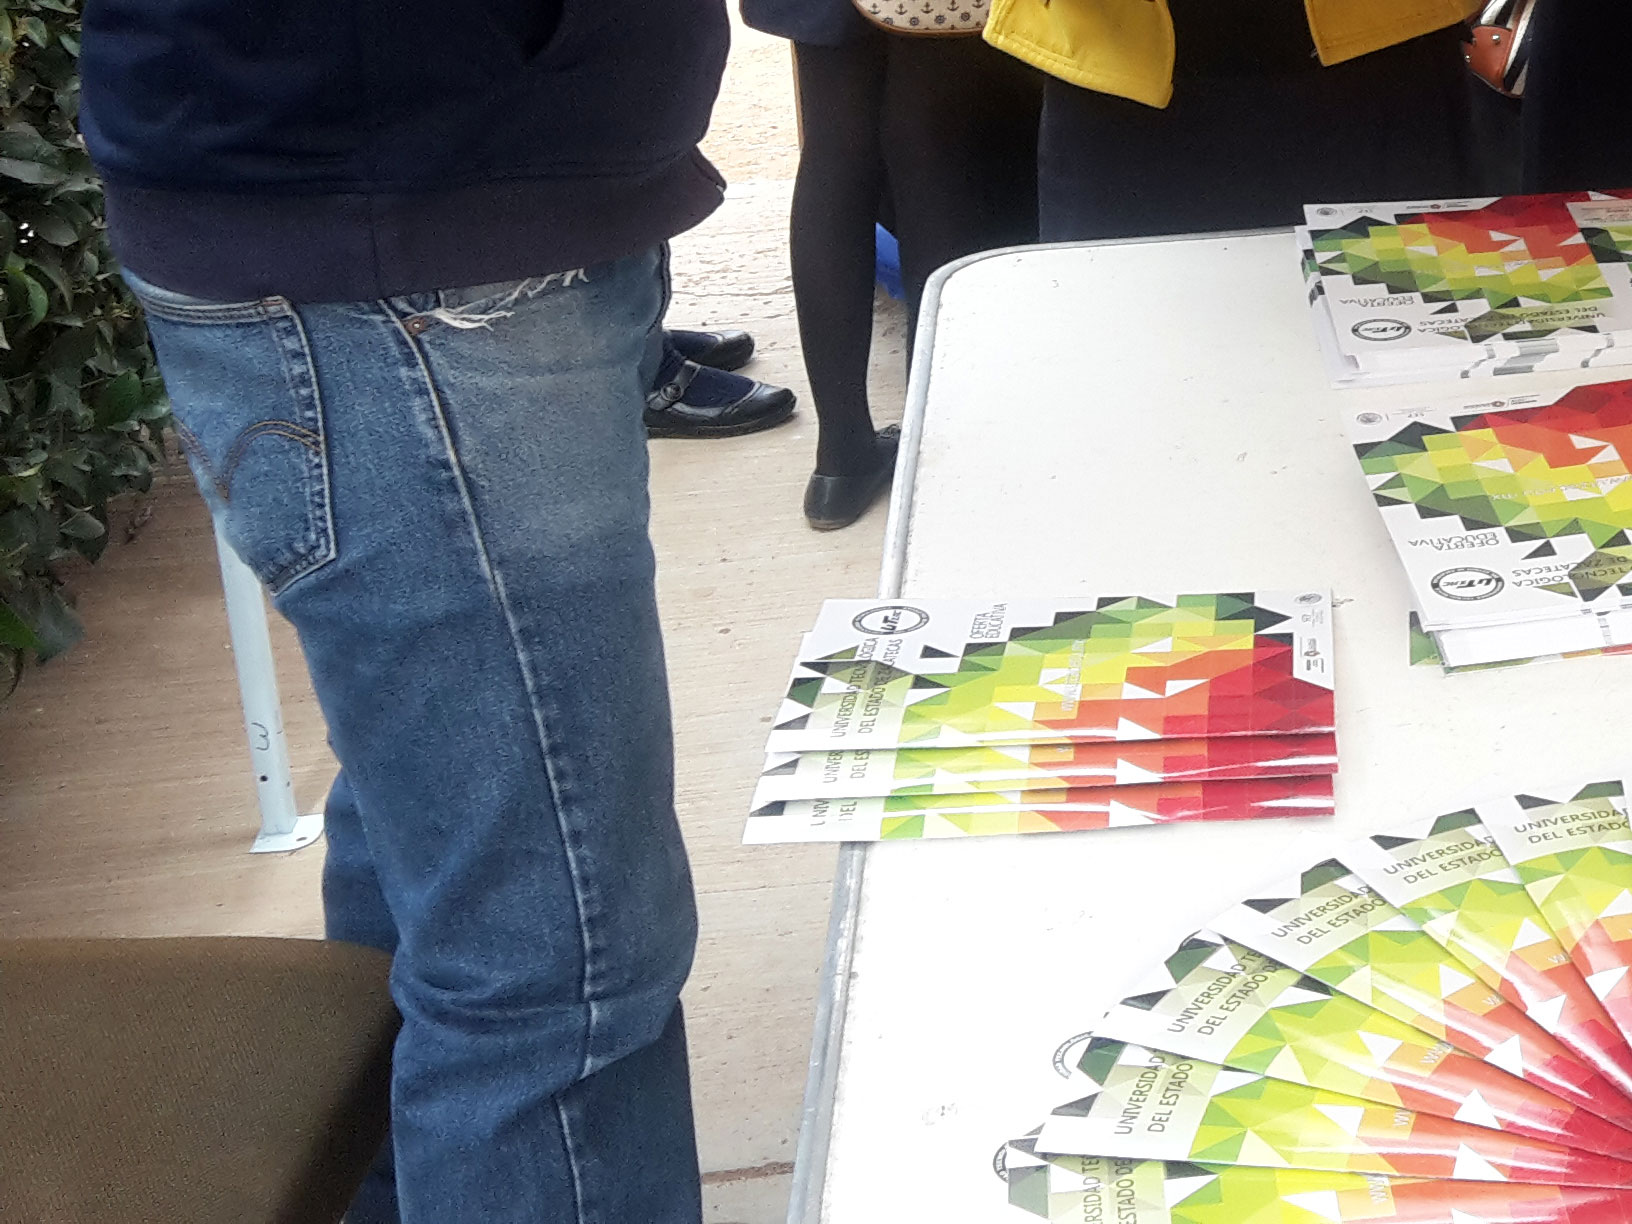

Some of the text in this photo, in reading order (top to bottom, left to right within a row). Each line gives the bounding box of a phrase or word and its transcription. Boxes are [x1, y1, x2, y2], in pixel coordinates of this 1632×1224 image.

[1383, 836, 1494, 875] UNIVERSIDAD
[1527, 830, 1563, 844] DEL
[1404, 867, 1436, 884] DEL
[1271, 883, 1371, 939] UNIVERSIDAD
[1296, 897, 1387, 945] DEL ESTADO
[1167, 964, 1246, 1033] UNIVERSIDAD
[1197, 1014, 1227, 1036] DEL
[1219, 971, 1267, 1015] ESTADO
[1114, 1056, 1166, 1134] UNIVERSIDAD
[1148, 1062, 1194, 1133] DEL ESTADO
